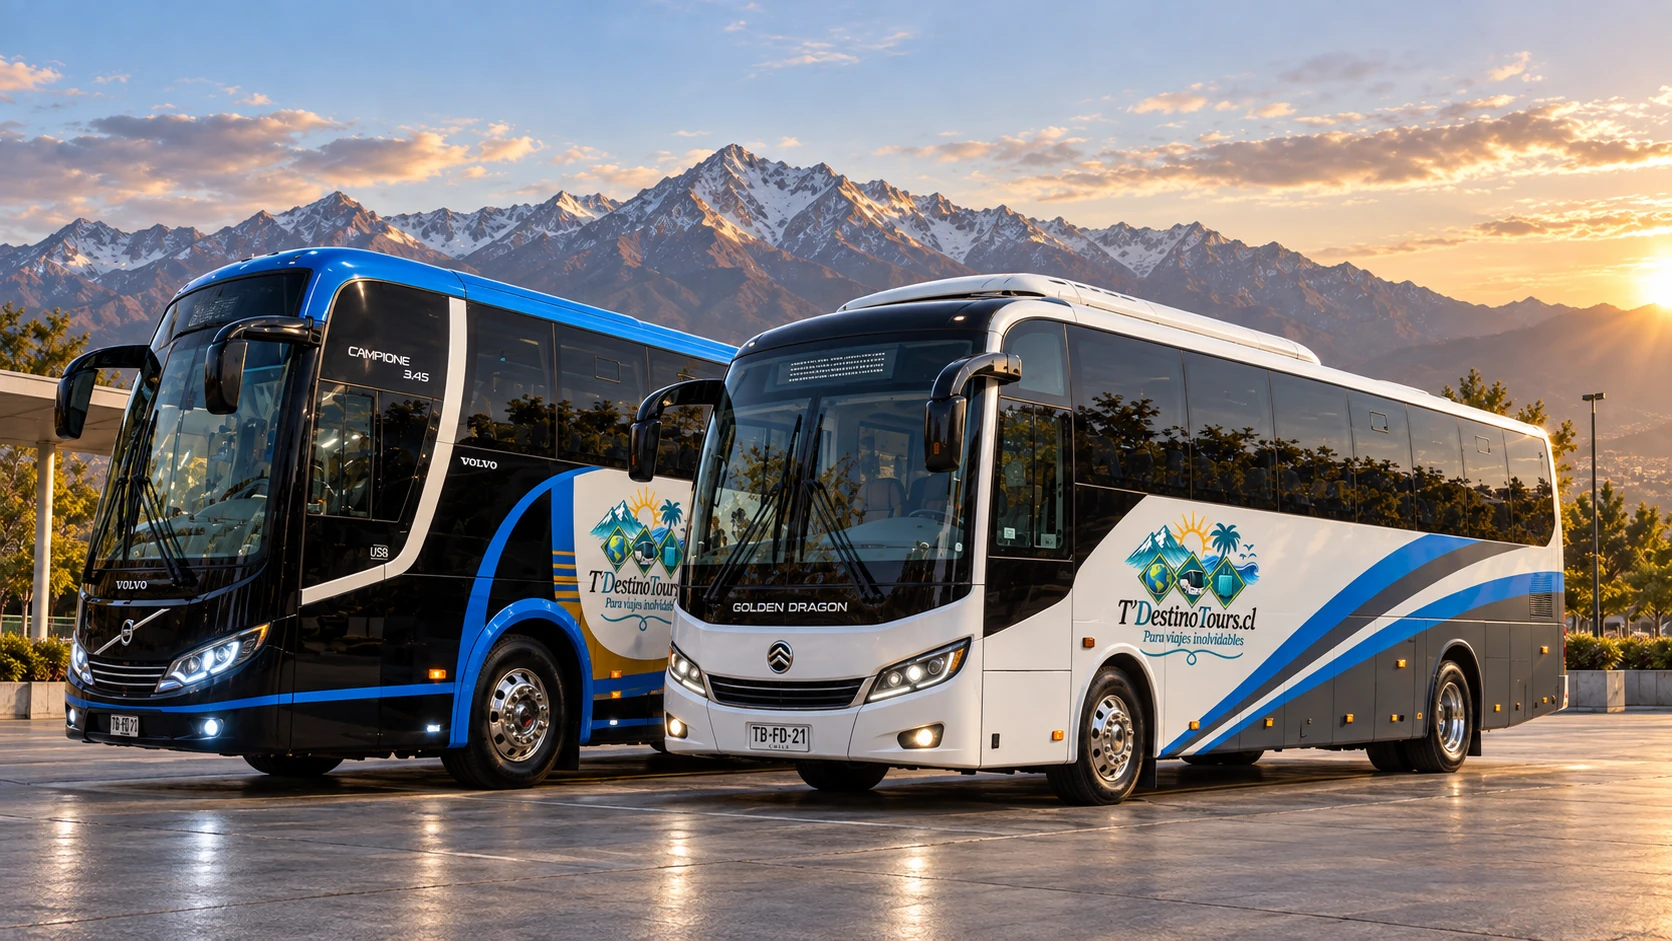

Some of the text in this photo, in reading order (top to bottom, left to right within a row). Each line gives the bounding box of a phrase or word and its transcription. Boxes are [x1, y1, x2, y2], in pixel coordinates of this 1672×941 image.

[348, 346, 410, 366] CAMPIONE
[460, 456, 498, 470] VOLVO
[116, 580, 148, 590] VOLVO
[732, 602, 848, 612] GOLDEN DRAGON
[1143, 630, 1245, 647] Para viajes inolvidables
